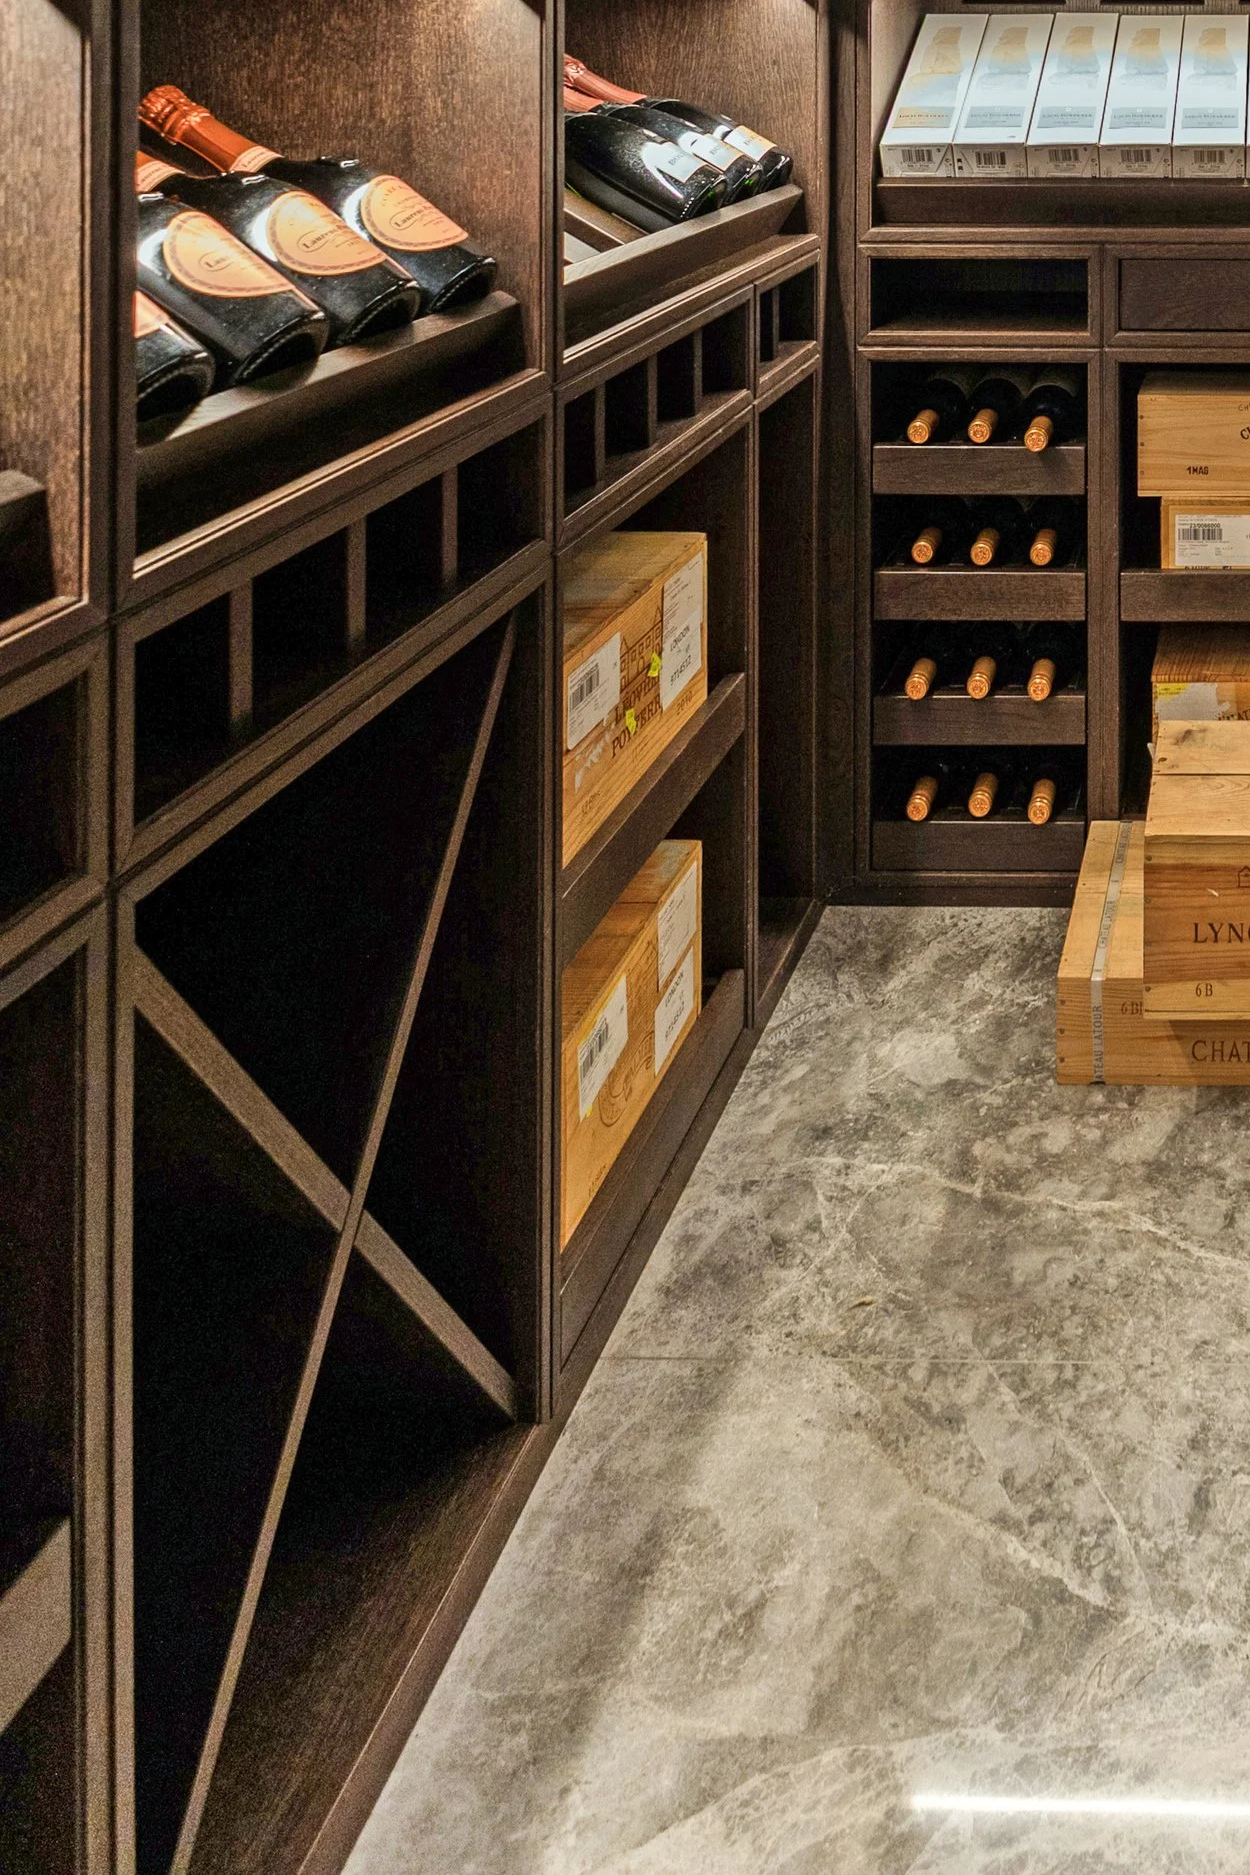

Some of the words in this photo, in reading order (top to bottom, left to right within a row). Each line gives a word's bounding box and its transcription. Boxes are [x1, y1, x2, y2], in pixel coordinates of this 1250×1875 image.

[668, 625, 690, 652] LONDON
[1195, 983, 1202, 997] 6
[1205, 983, 1213, 997] B
[1121, 1002, 1129, 1016] 6
[1131, 1002, 1143, 1015] B
[1093, 1005, 1103, 1047] LATOUR
[1093, 1048, 1103, 1083] ATEAU
